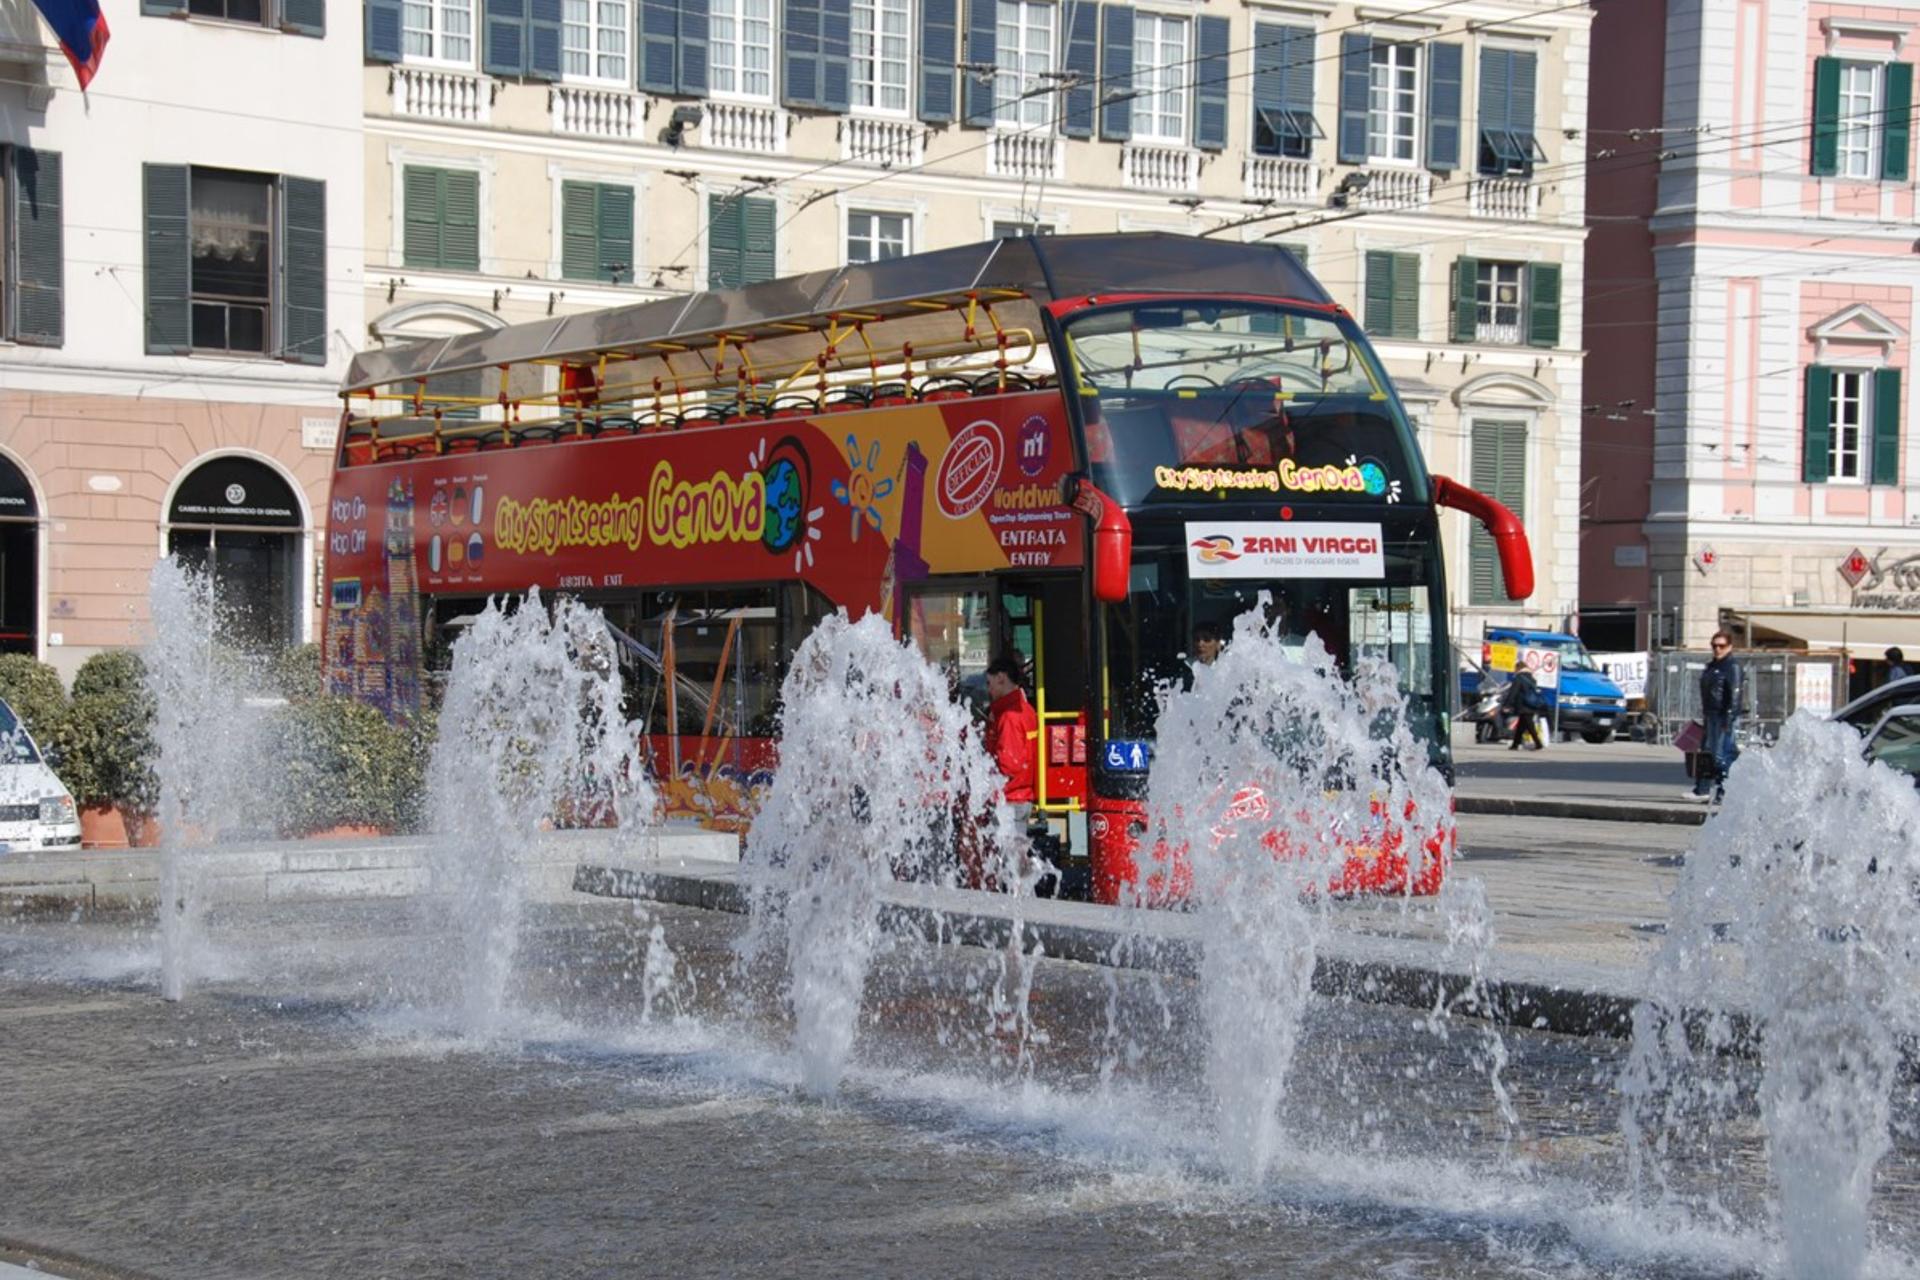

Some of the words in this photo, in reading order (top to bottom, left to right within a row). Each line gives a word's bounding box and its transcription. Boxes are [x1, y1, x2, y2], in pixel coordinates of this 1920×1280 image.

[1279, 458, 1365, 492] Genova
[994, 483, 1064, 509] Worldwi
[178, 505, 208, 513] CAMERA
[216, 507, 256, 515] COMMERCIO
[265, 508, 292, 516] GENOVA
[332, 500, 350, 523] Hop
[352, 496, 366, 520] On
[495, 493, 643, 555] CitySightseeing
[649, 460, 766, 549] Genova
[331, 531, 349, 555] Hop
[352, 529, 367, 553] Off
[1001, 529, 1067, 546] ENTRATA
[1242, 537, 1297, 554] ZANI
[1302, 537, 1377, 554] VIAGGI
[1010, 551, 1052, 566] ENTRY
[604, 574, 623, 586] EXIT
